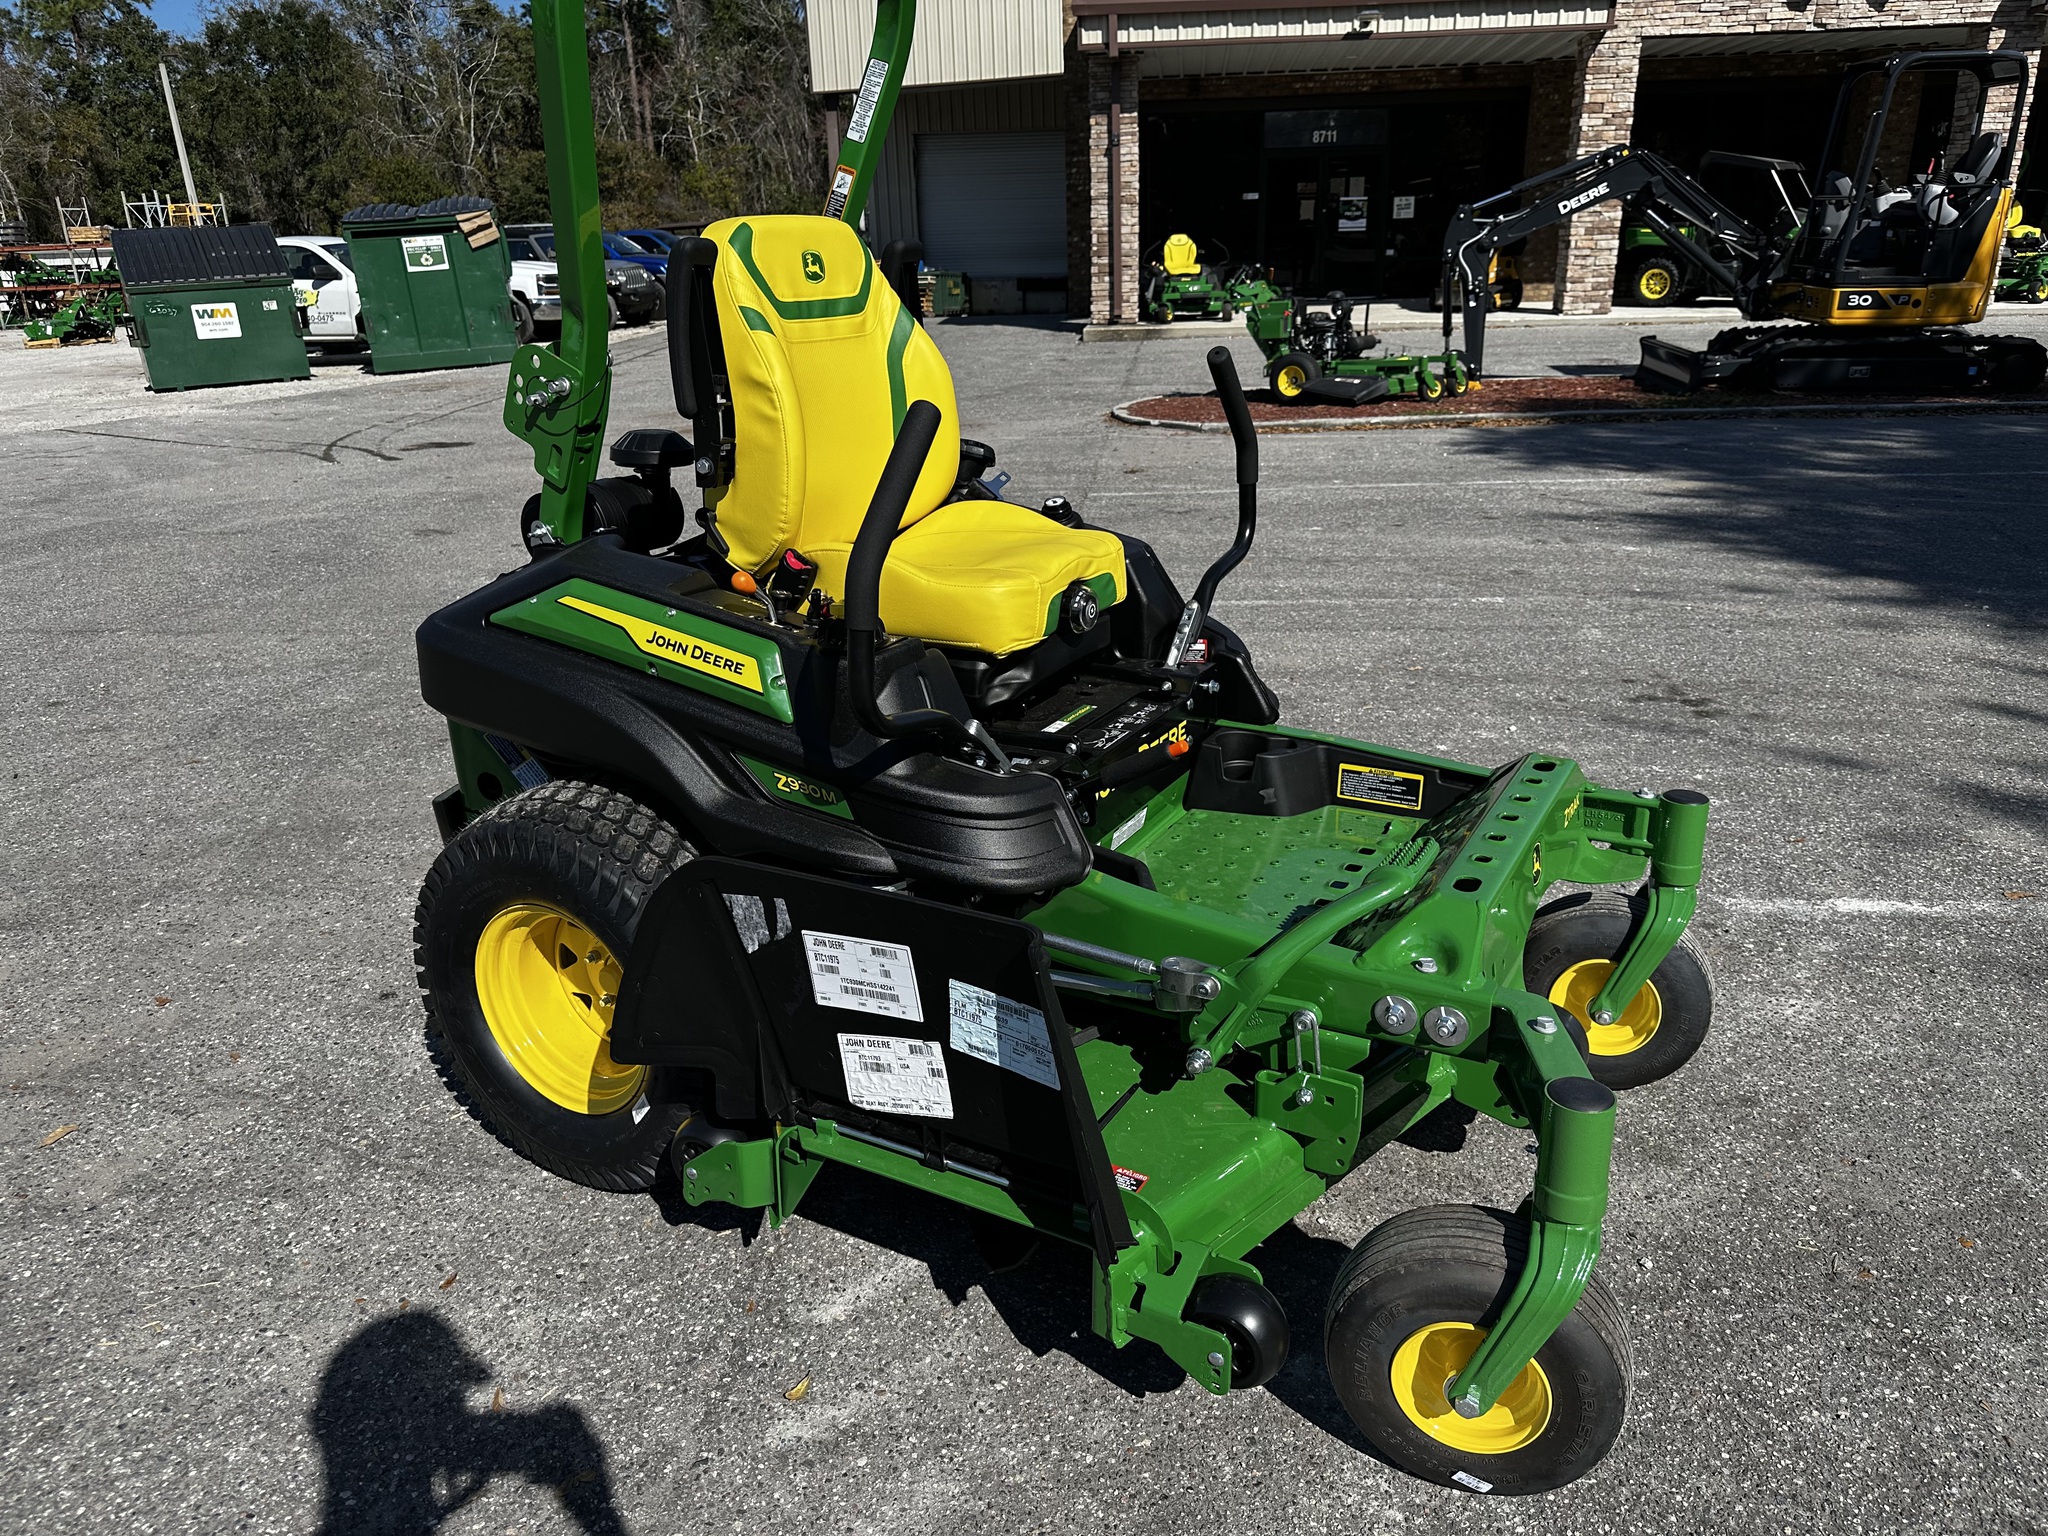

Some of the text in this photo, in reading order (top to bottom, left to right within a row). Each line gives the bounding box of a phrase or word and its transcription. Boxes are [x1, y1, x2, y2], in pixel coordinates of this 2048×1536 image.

[1312, 130, 1337, 143] 8711
[1557, 181, 1610, 215] DEERE
[1848, 295, 1873, 306] 30
[195, 308, 233, 319] WM
[646, 631, 746, 676] JOHN DEERE
[813, 938, 846, 951] JOHN DEERE
[845, 1038, 892, 1050] JOHN DEERE
[1121, 1169, 1148, 1181] PELIGRO
[1353, 1302, 1407, 1402] RELIANCE
[1554, 1369, 1596, 1468] CARLSTAR
